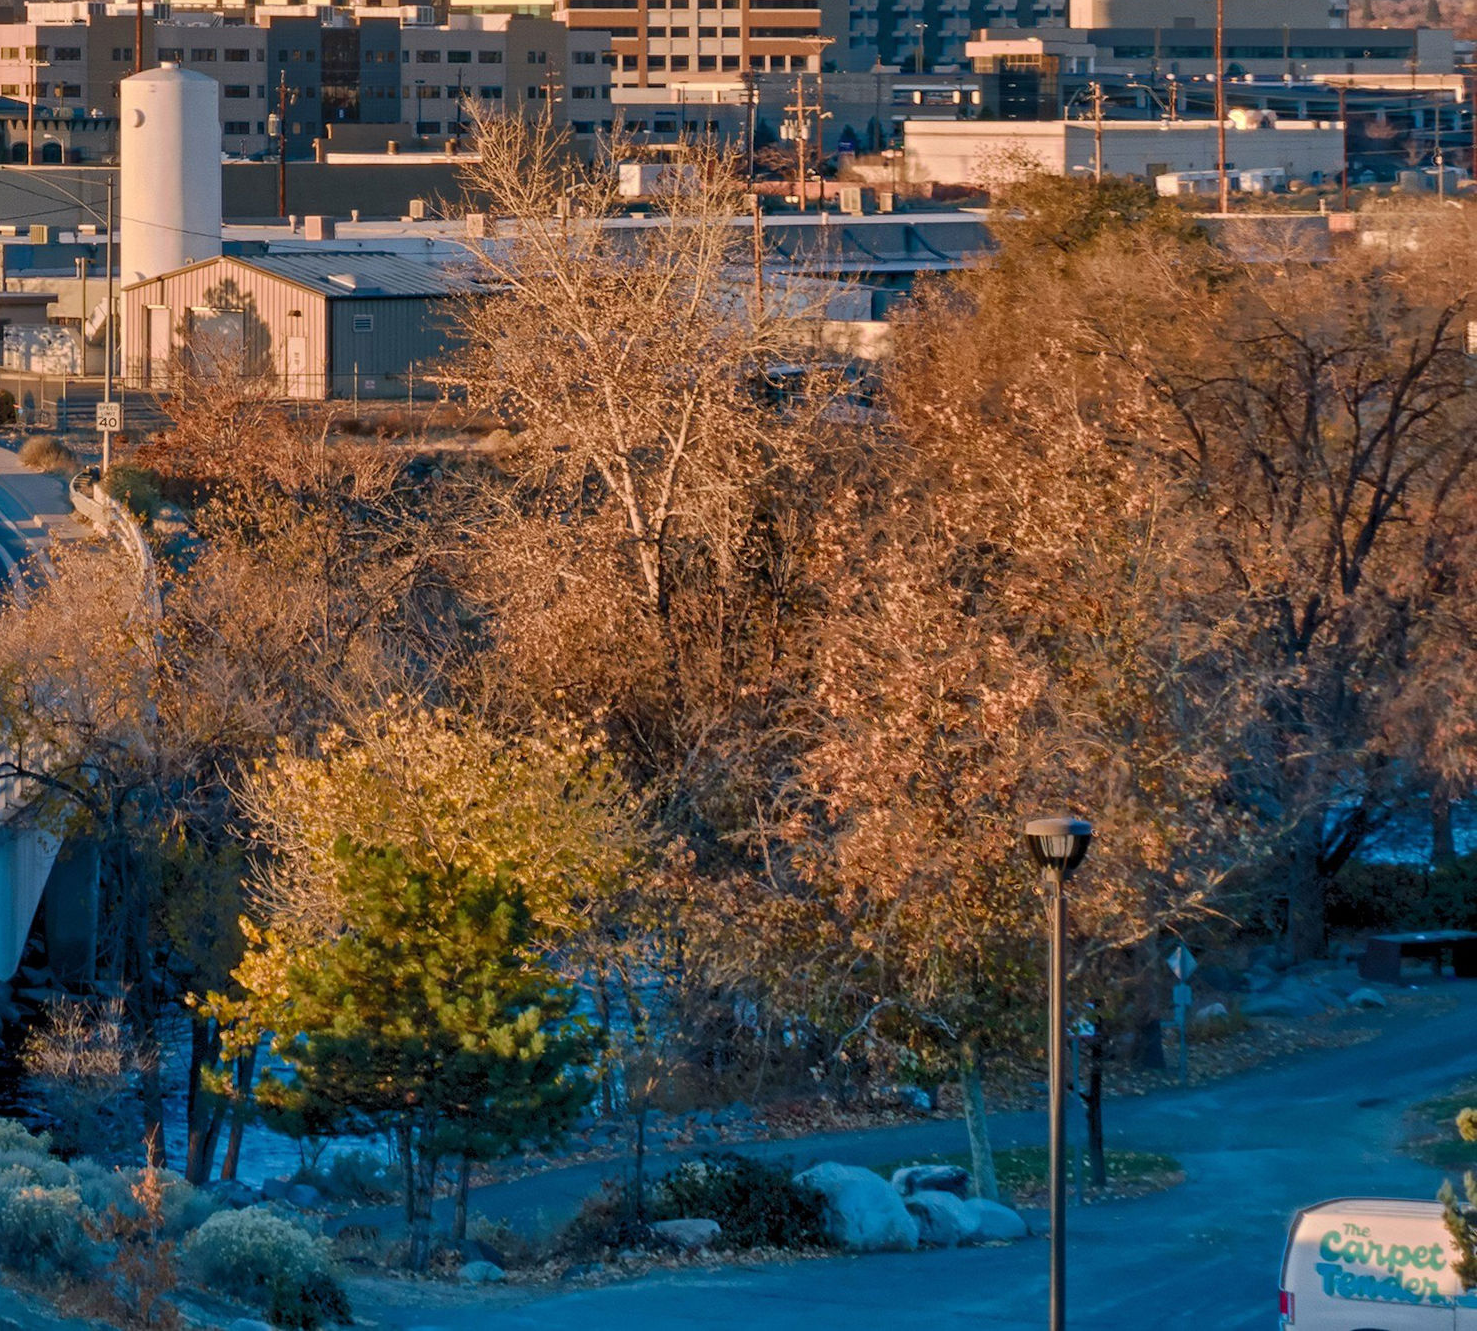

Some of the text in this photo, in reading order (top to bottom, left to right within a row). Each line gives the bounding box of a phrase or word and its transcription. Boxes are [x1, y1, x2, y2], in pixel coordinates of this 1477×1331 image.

[99, 417, 117, 428] 40
[1342, 1223, 1371, 1238] The
[1319, 1230, 1447, 1274] Carpet
[1315, 1262, 1447, 1306] Tender
